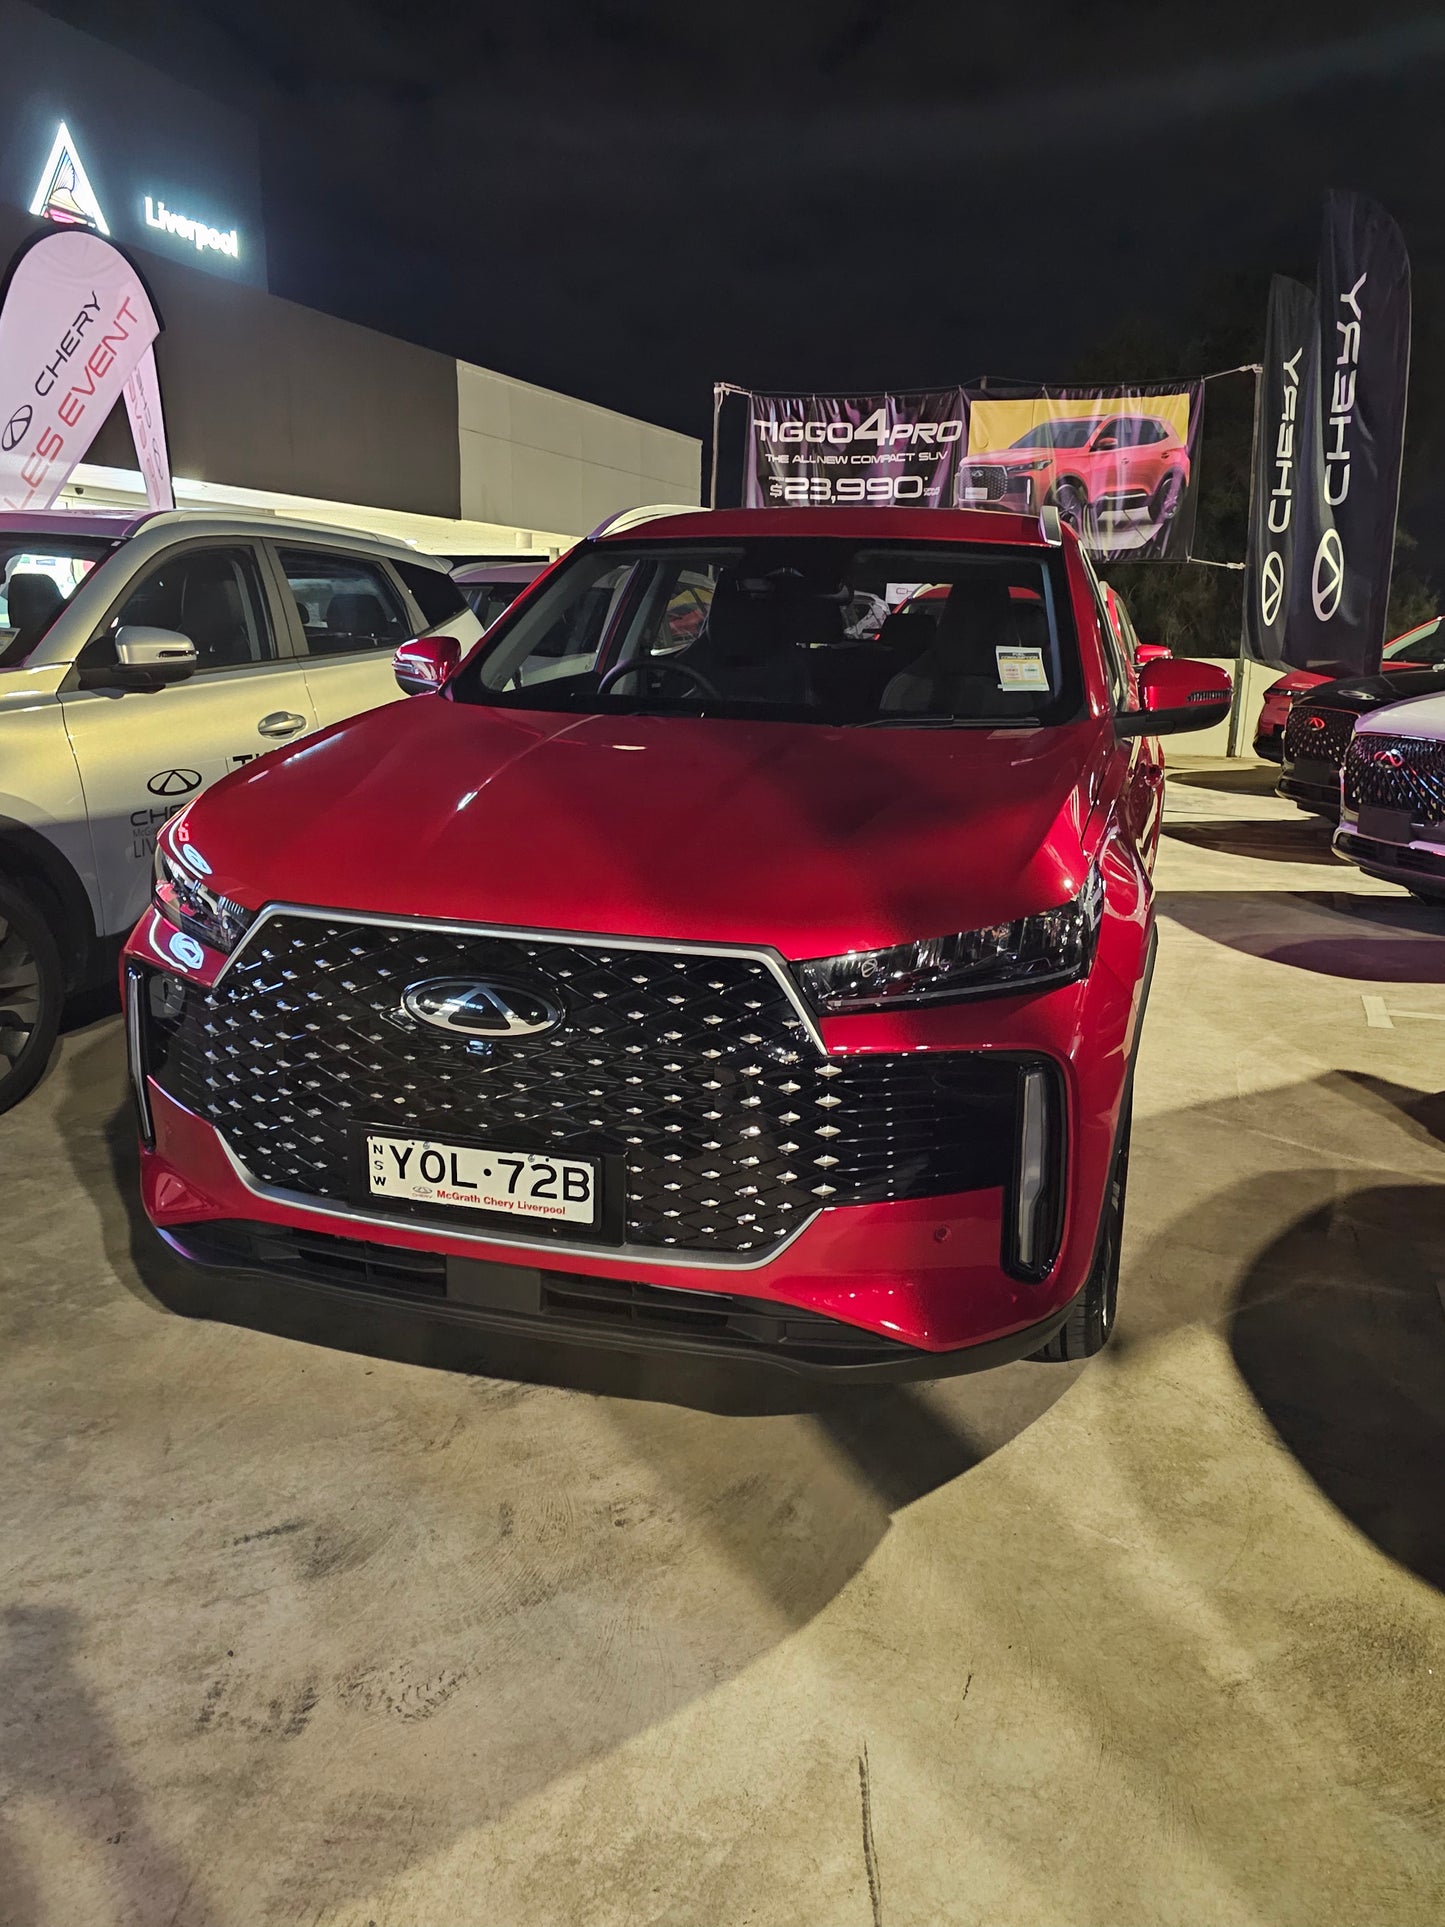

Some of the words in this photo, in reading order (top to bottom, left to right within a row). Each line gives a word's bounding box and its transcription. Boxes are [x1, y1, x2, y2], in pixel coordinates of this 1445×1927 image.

[144, 196, 239, 259] Liverpool
[34, 290, 101, 397] CHERY
[57, 296, 139, 428] EVENT
[765, 453, 789, 464] THE
[850, 453, 916, 465] COMPACT
[918, 451, 949, 462] SUV
[436, 1190, 481, 1204] McGrath
[483, 1196, 515, 1209] Chery
[517, 1200, 566, 1215] Liverpool
